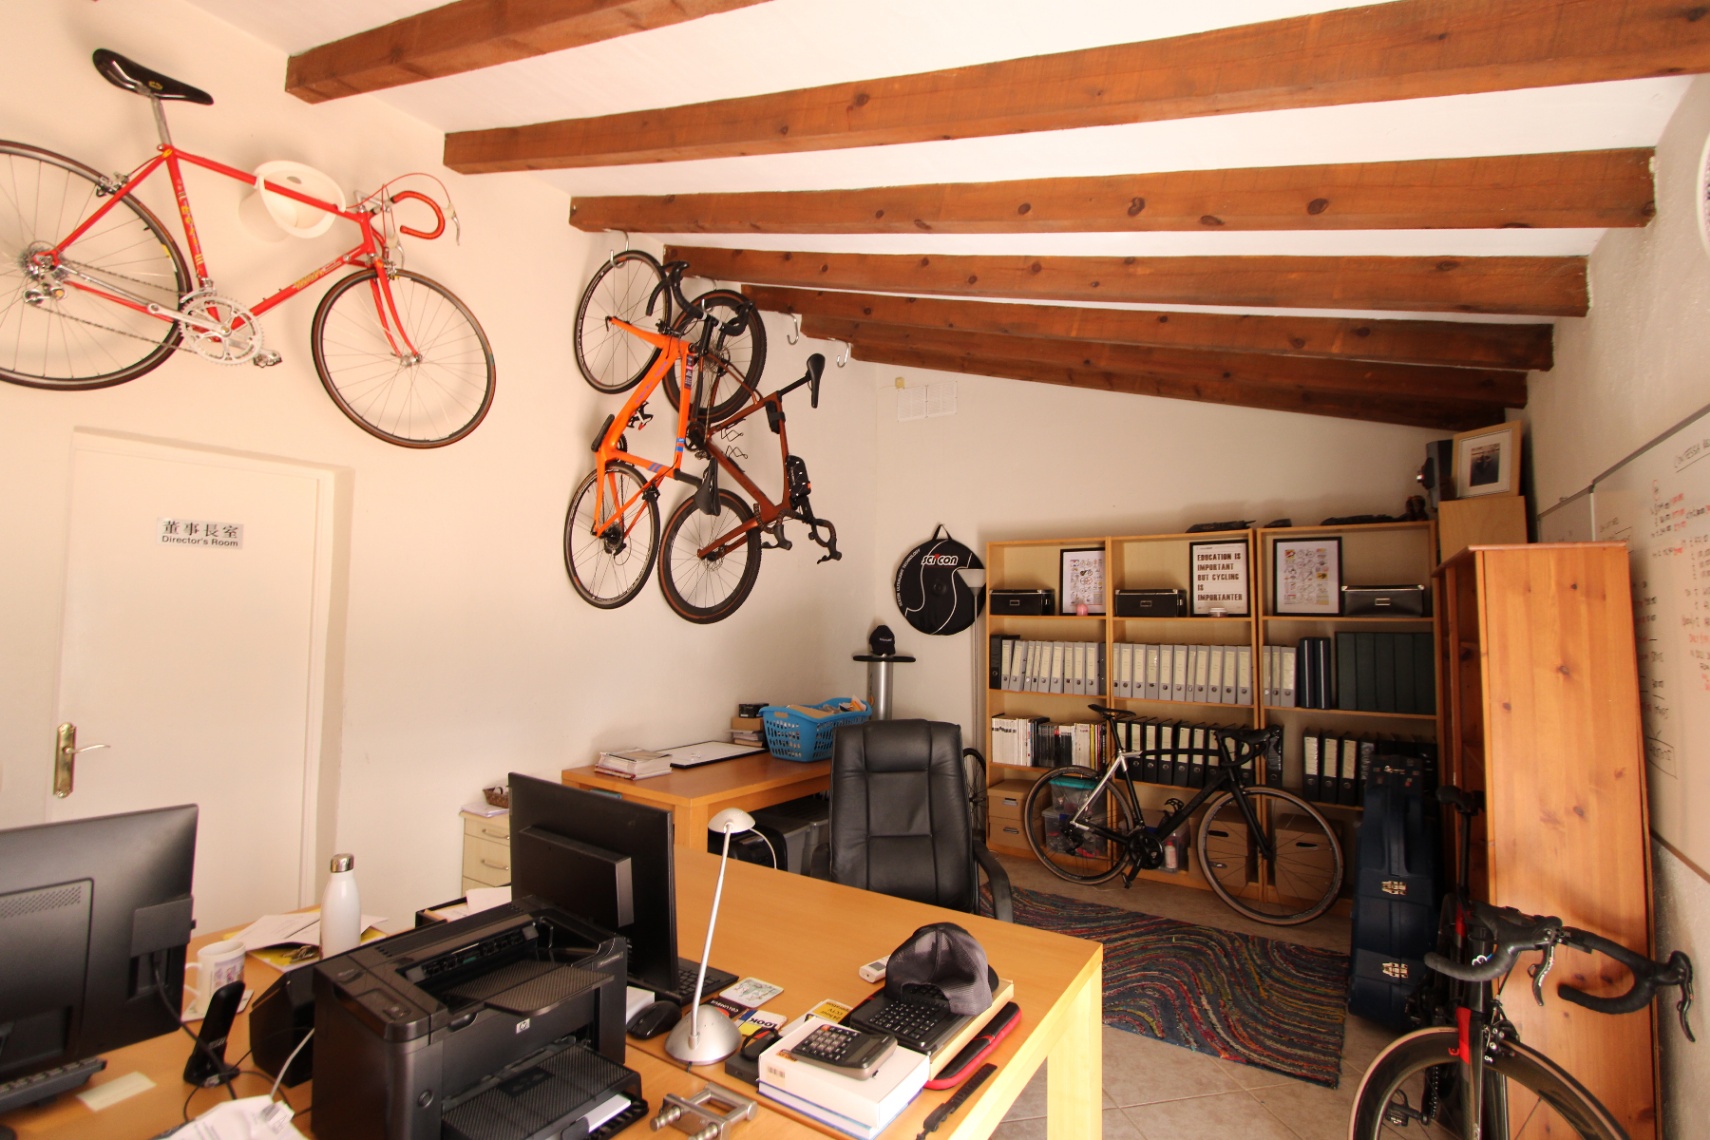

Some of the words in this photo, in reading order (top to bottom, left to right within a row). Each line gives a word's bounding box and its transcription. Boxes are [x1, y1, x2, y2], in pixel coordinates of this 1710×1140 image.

[163, 520, 239, 539] 董事長室
[161, 535, 209, 546] Director's
[211, 538, 239, 547] Room
[1197, 553, 1232, 561] EDUCATION
[1234, 552, 1241, 560] IS
[1197, 563, 1234, 571] IMPORTANT
[1212, 573, 1240, 581] CYCLING
[1197, 593, 1243, 601] IMPORTANTER
